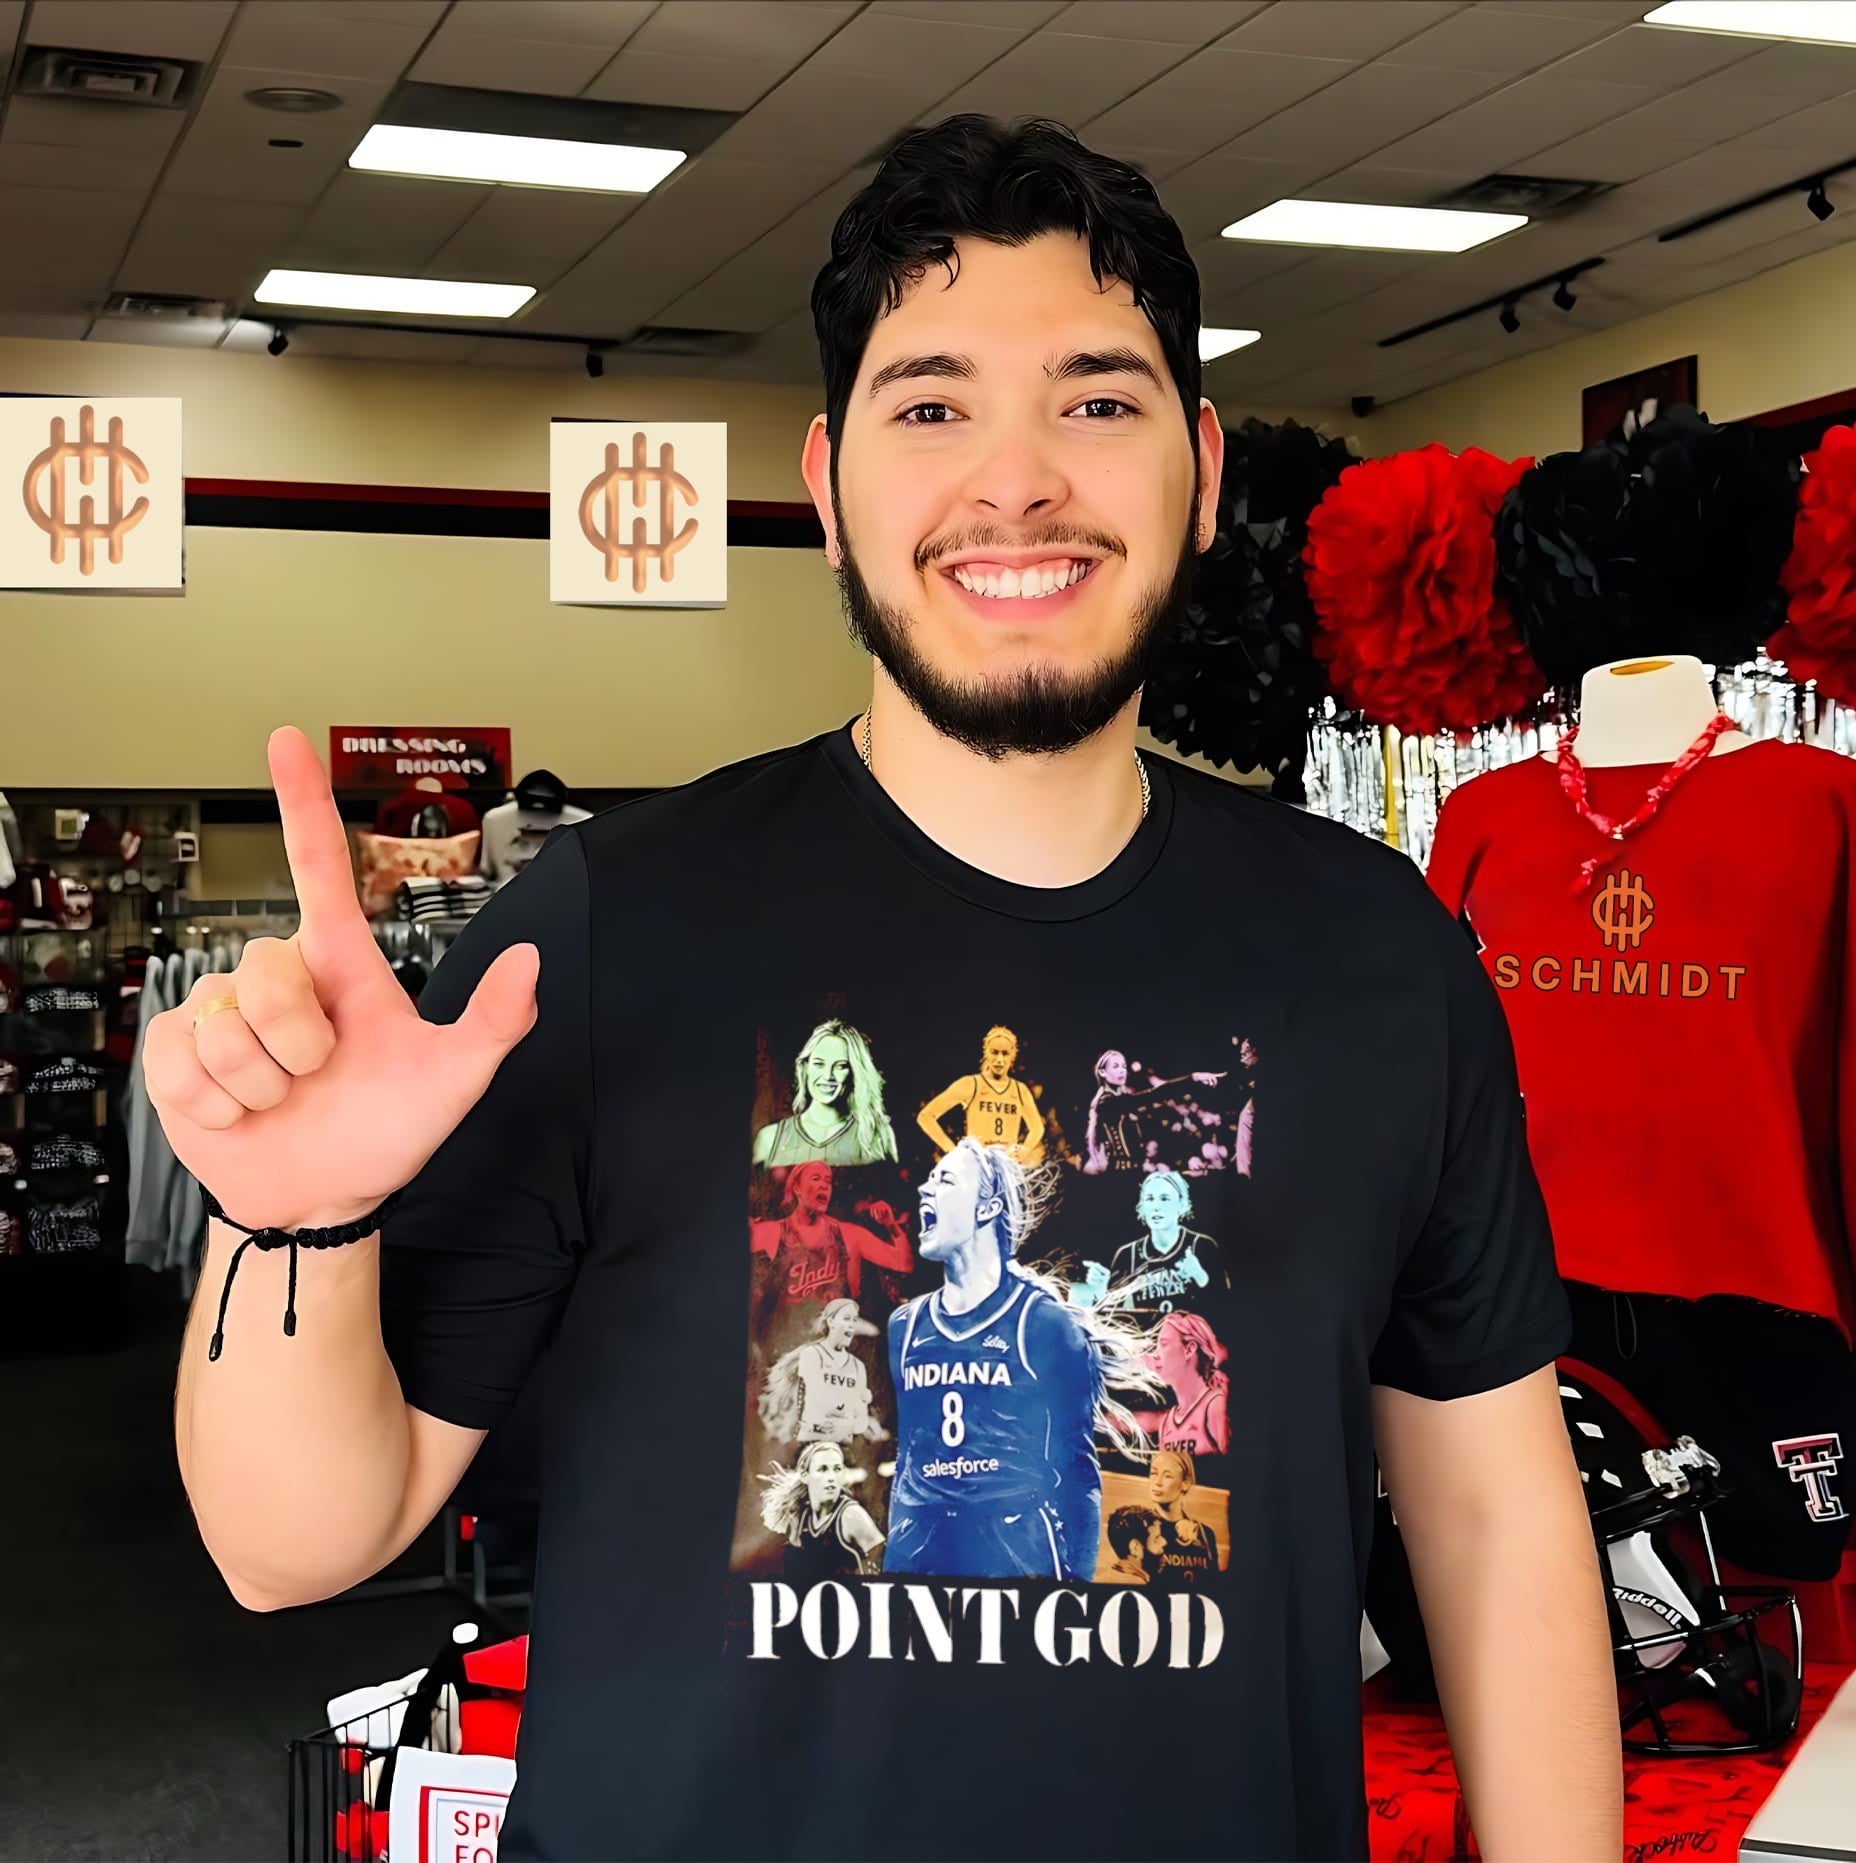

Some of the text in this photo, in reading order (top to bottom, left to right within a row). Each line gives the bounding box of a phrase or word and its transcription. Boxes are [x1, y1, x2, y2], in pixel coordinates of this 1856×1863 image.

[1494, 953, 1746, 1000] SCHMIDT
[979, 1101, 1018, 1115] FEVER
[994, 1117, 1003, 1136] 8
[788, 1253, 841, 1298] Indy
[904, 1361, 1012, 1391] INDIANA
[941, 1391, 965, 1448] 8
[922, 1456, 1000, 1479] salesforce
[747, 1580, 1225, 1669] POINT GOD
[1612, 1587, 1682, 1626] Riddell
